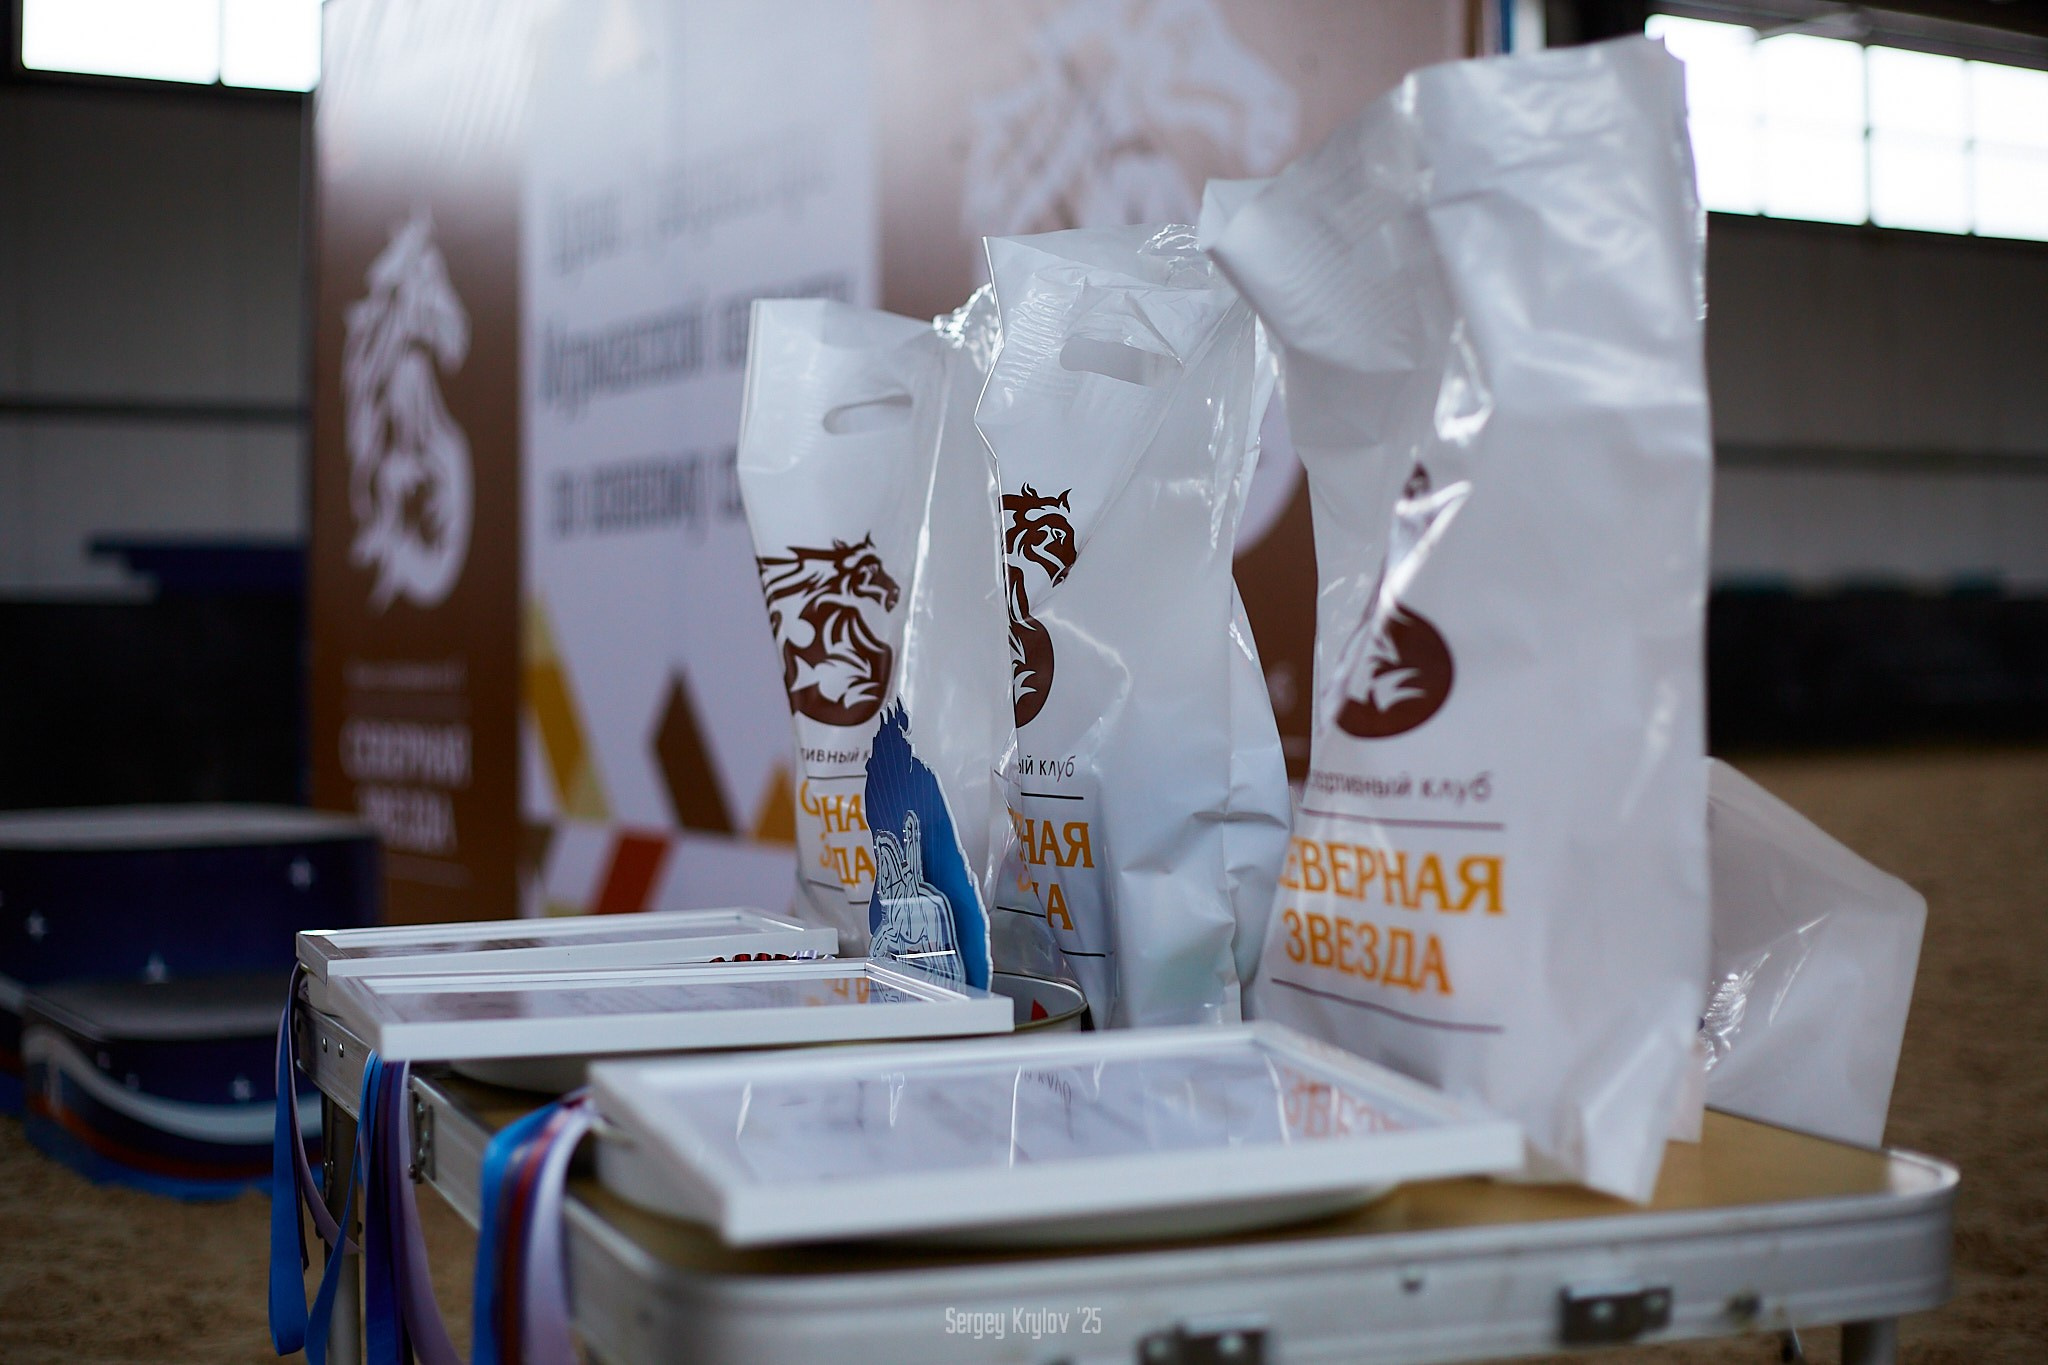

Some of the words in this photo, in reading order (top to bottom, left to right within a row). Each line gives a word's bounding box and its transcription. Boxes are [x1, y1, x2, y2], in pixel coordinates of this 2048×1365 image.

[1039, 755, 1076, 782] клуб
[1420, 770, 1493, 806] клуб
[1282, 907, 1454, 996] ЗВЕЗДА
